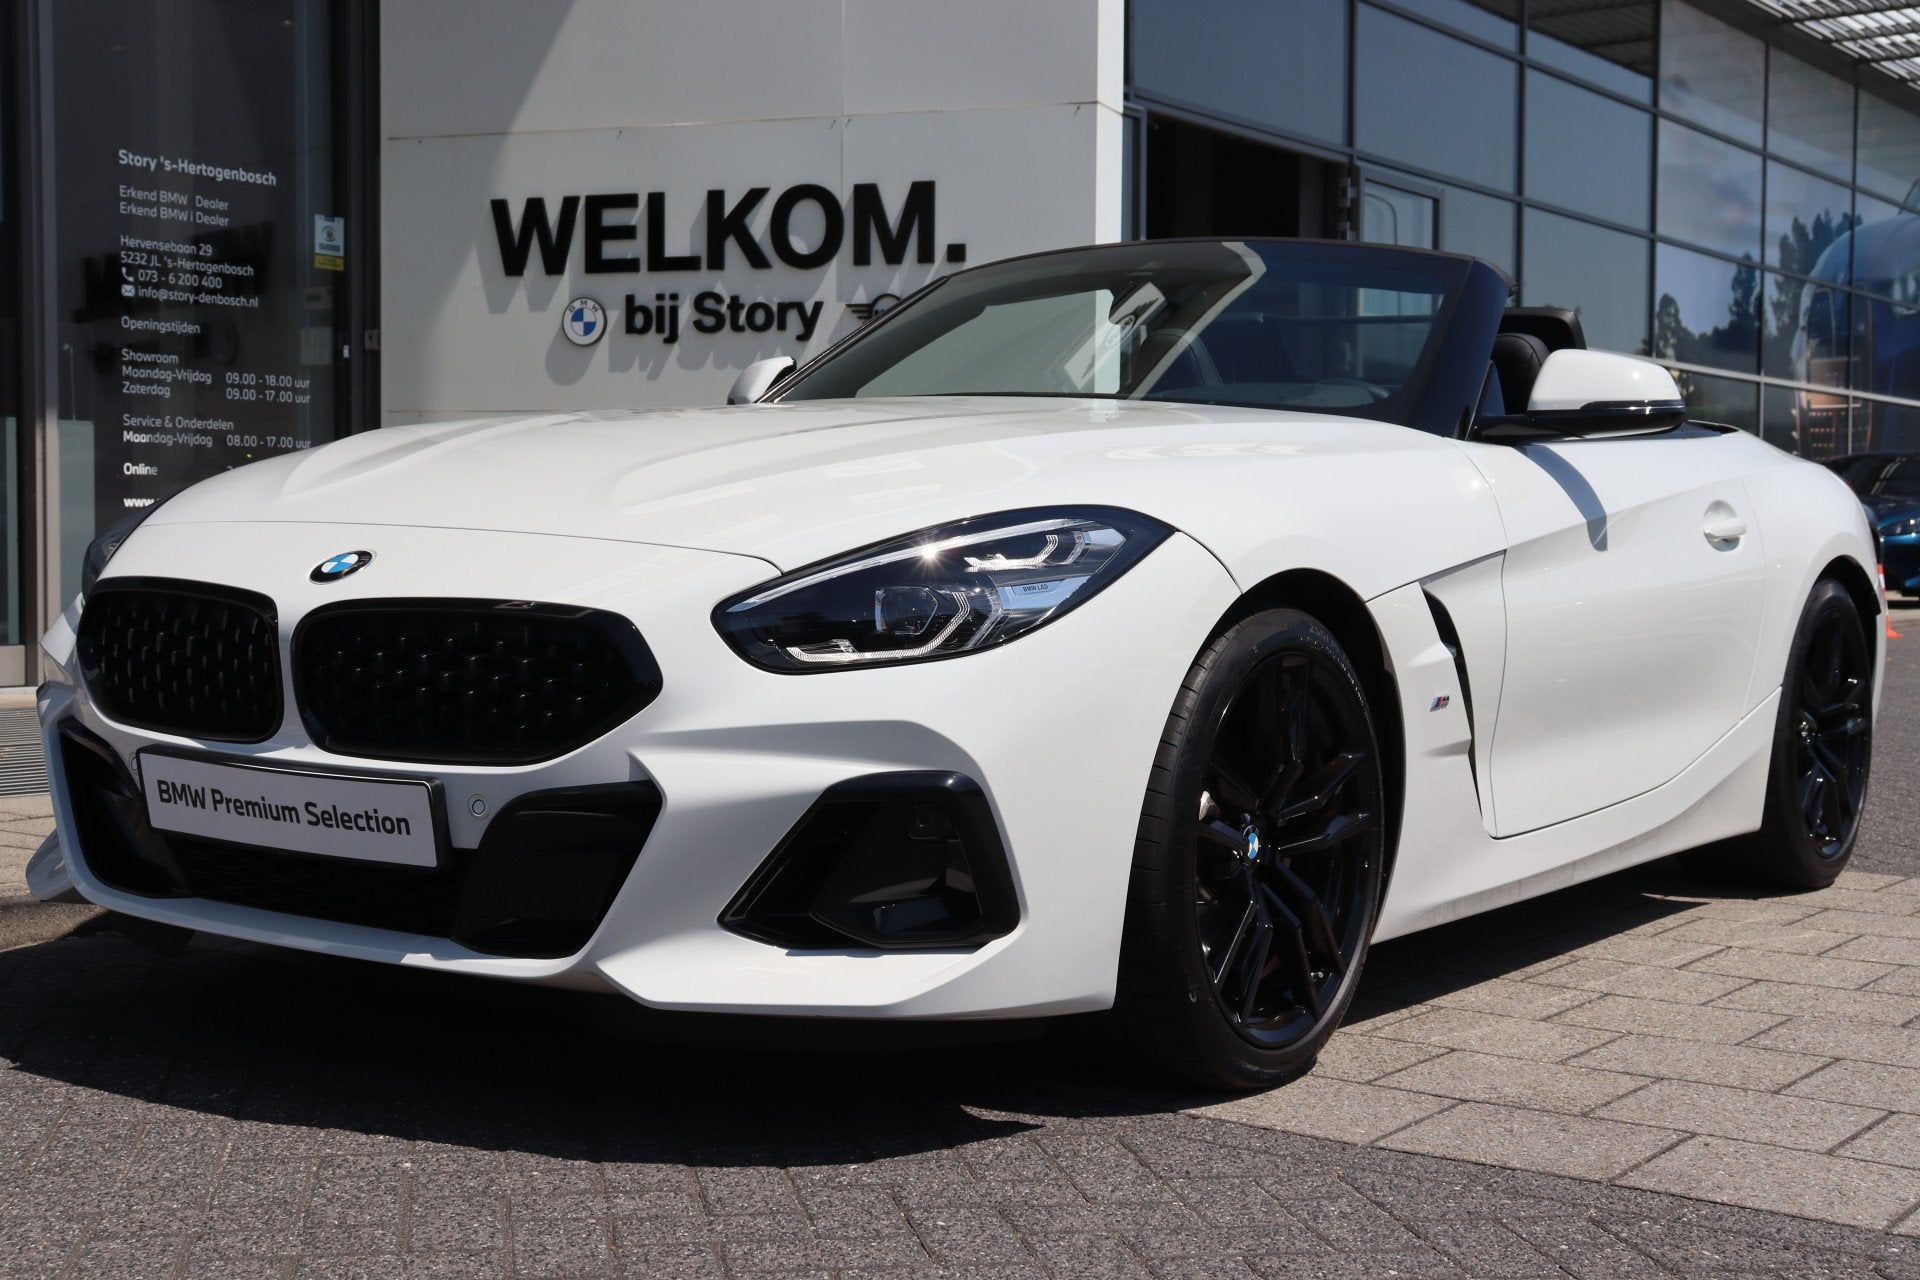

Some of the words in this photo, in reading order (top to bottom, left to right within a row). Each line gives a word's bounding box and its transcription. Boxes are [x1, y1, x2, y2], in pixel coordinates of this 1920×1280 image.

[118, 149, 157, 172] Story
[160, 156, 276, 186] 's-Hertogenbosch
[120, 185, 157, 201] Erkend
[160, 190, 188, 205] BMW
[196, 195, 229, 210] Dealer
[120, 202, 157, 218] Erkend
[160, 207, 188, 221] BMW
[196, 212, 229, 226] Dealer
[490, 180, 967, 276] WELKOM.
[120, 234, 197, 254] Hervensebaan
[199, 244, 212, 256] 29
[120, 250, 147, 264] 5232
[150, 255, 162, 266] JL
[164, 256, 254, 276] 's-Hertogenbosch
[138, 269, 158, 282] 073
[168, 272, 176, 284] 6
[178, 273, 199, 286] 200
[201, 276, 222, 289] 400
[138, 286, 258, 308] info@story-denbosch.nl
[121, 316, 200, 334] Openingstijden
[625, 292, 680, 344] bij
[692, 292, 823, 341] Story
[122, 348, 179, 364] Showroom
[122, 365, 212, 385] Maandag-Vrijdag
[226, 372, 256, 385] 09.00
[265, 374, 292, 387] 18.00
[294, 380, 310, 388] uur
[122, 381, 170, 398] Zaterdag
[226, 388, 256, 401] 09.00
[295, 395, 310, 404] uur
[123, 414, 162, 427] Service
[164, 416, 172, 428] &
[175, 416, 234, 430] Onderdelen
[123, 430, 213, 448] Maandag-Vrijdag
[226, 434, 257, 447] 08.00
[266, 436, 293, 448] 17.00
[123, 462, 158, 476] Online
[156, 780, 206, 810] BMW
[211, 788, 300, 824] Premium
[304, 802, 411, 836] Selection
